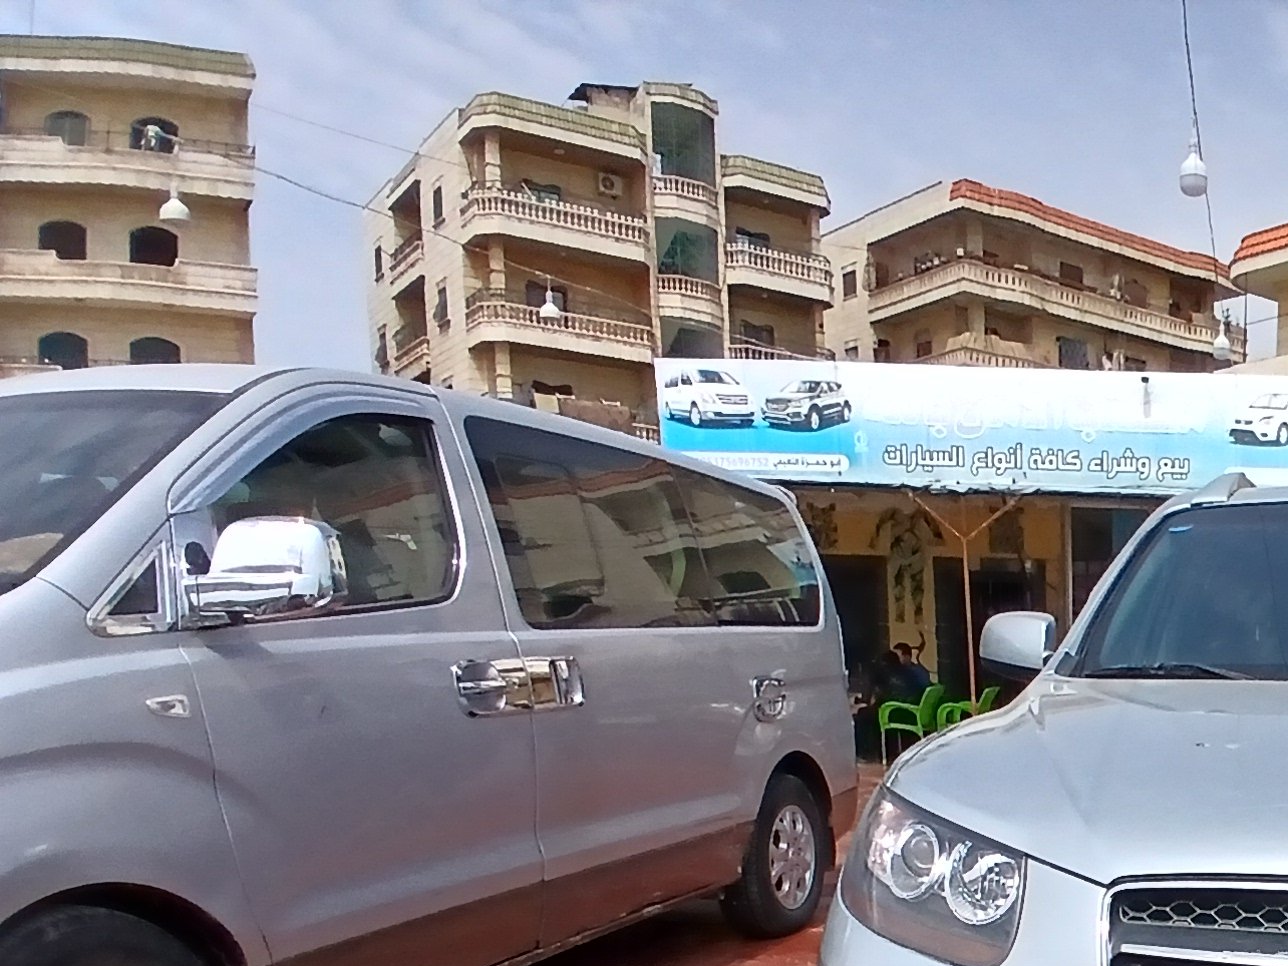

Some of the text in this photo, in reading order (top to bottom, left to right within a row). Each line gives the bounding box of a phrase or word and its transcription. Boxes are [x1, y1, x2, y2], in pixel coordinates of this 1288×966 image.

[883, 442, 1190, 482] بيع وشراء كافة أنواع السيارات
